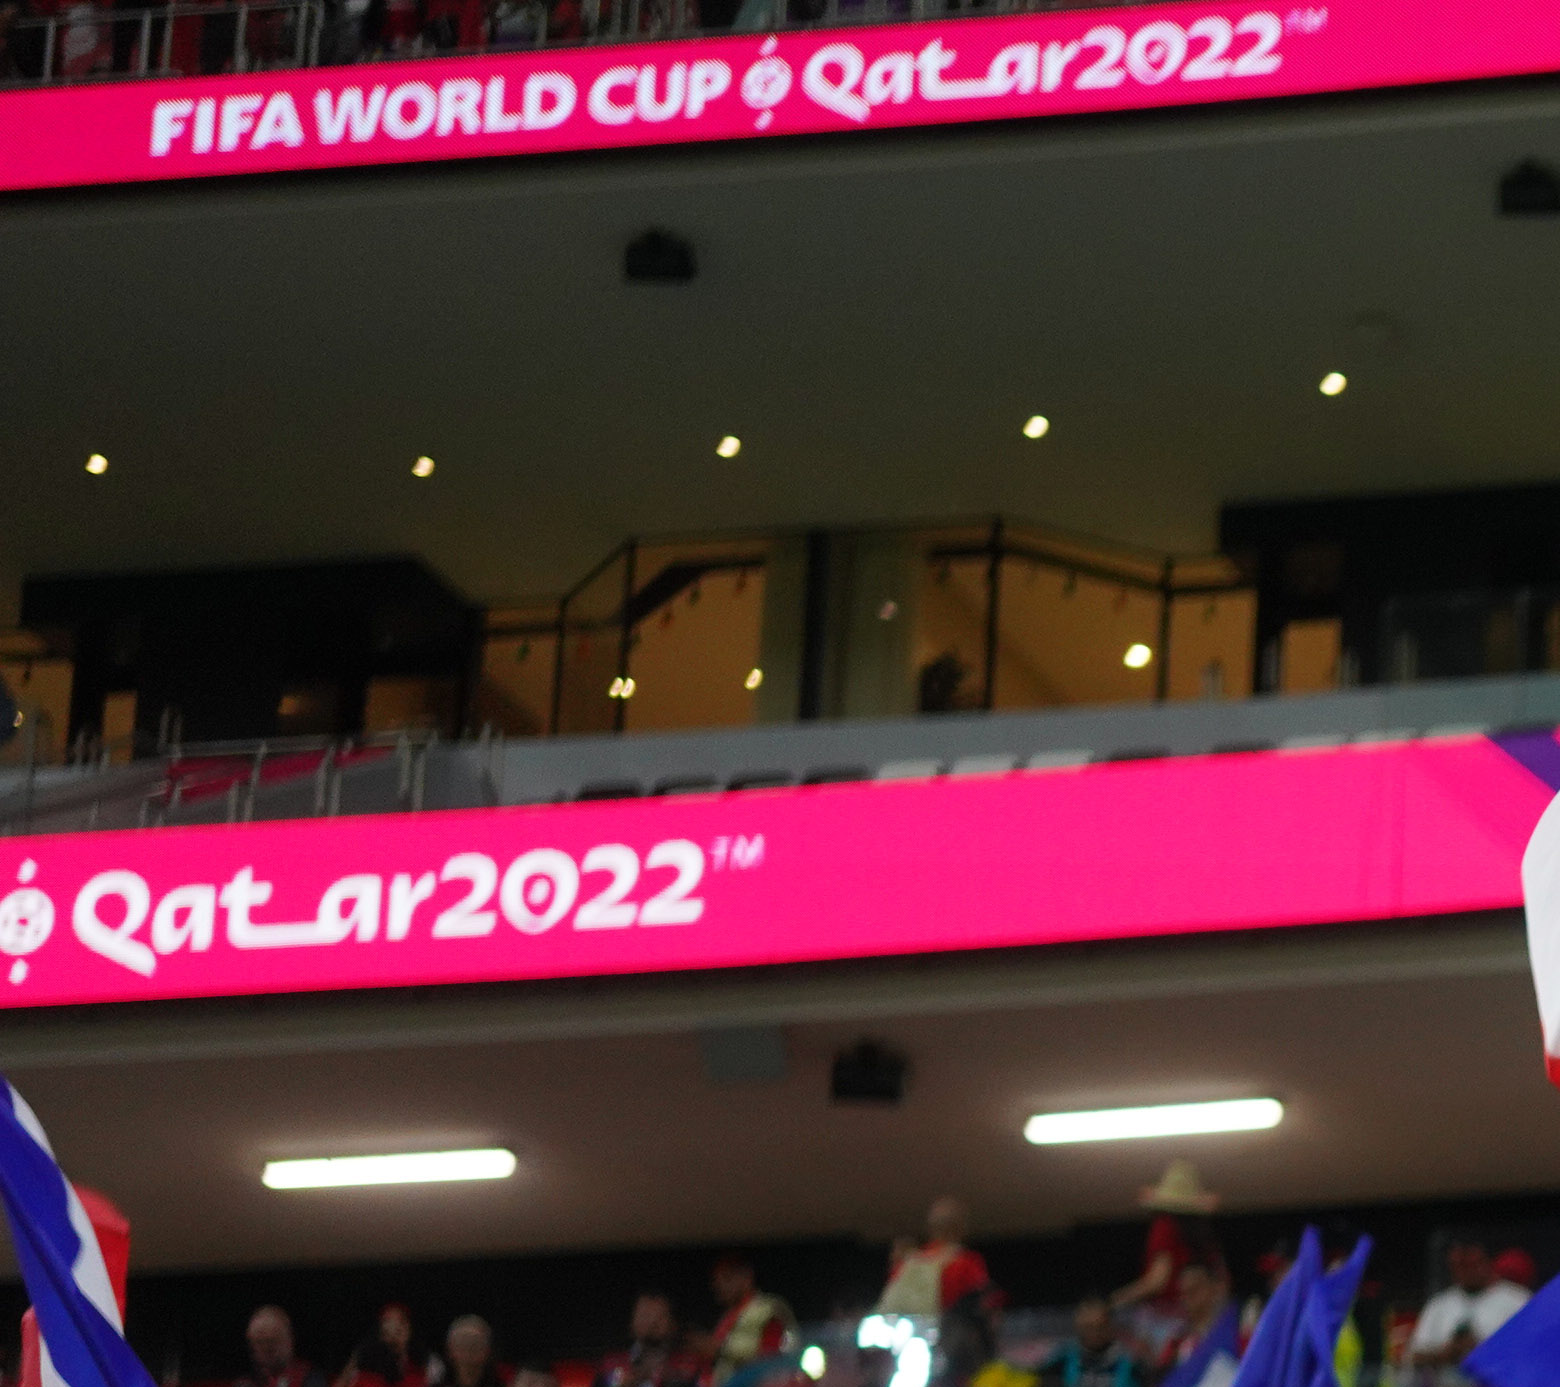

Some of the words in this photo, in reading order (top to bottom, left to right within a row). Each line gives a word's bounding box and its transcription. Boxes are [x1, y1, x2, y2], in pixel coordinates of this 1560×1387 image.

[149, 90, 304, 158] FIFA
[313, 70, 577, 145] WORLD
[588, 59, 732, 125] CUP
